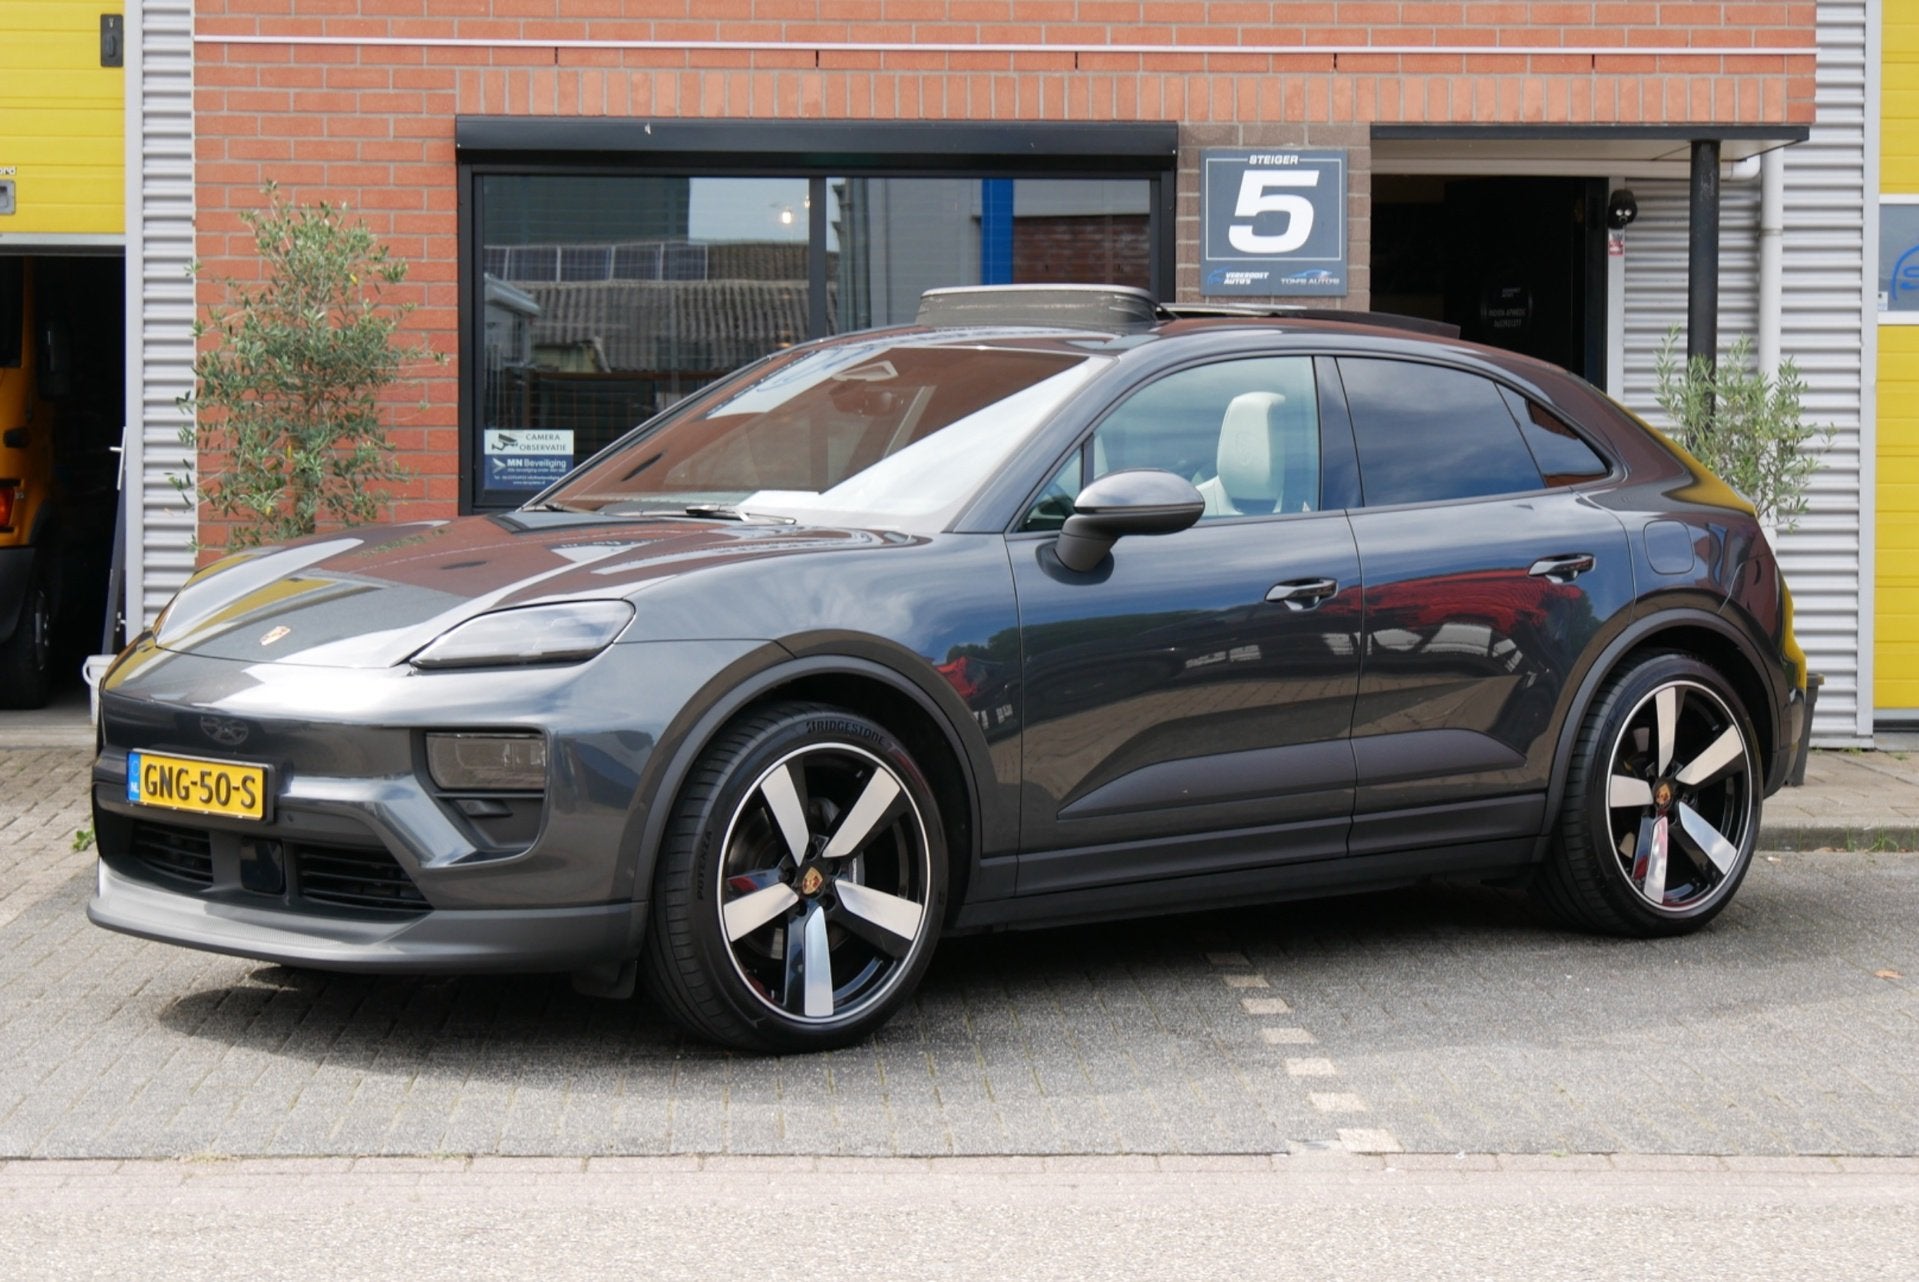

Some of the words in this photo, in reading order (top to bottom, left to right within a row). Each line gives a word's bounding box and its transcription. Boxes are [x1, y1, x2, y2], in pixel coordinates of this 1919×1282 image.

[1249, 155, 1298, 165] STEIGER
[1228, 170, 1320, 254] 5
[525, 433, 560, 441] CAMERA
[519, 443, 567, 451] OBSERVATIE
[507, 458, 523, 467] MN
[524, 458, 567, 469] Beveiliging
[806, 720, 885, 745] BRIDGESTONE
[130, 781, 139, 793] NL
[144, 763, 256, 810] GNG-50-S
